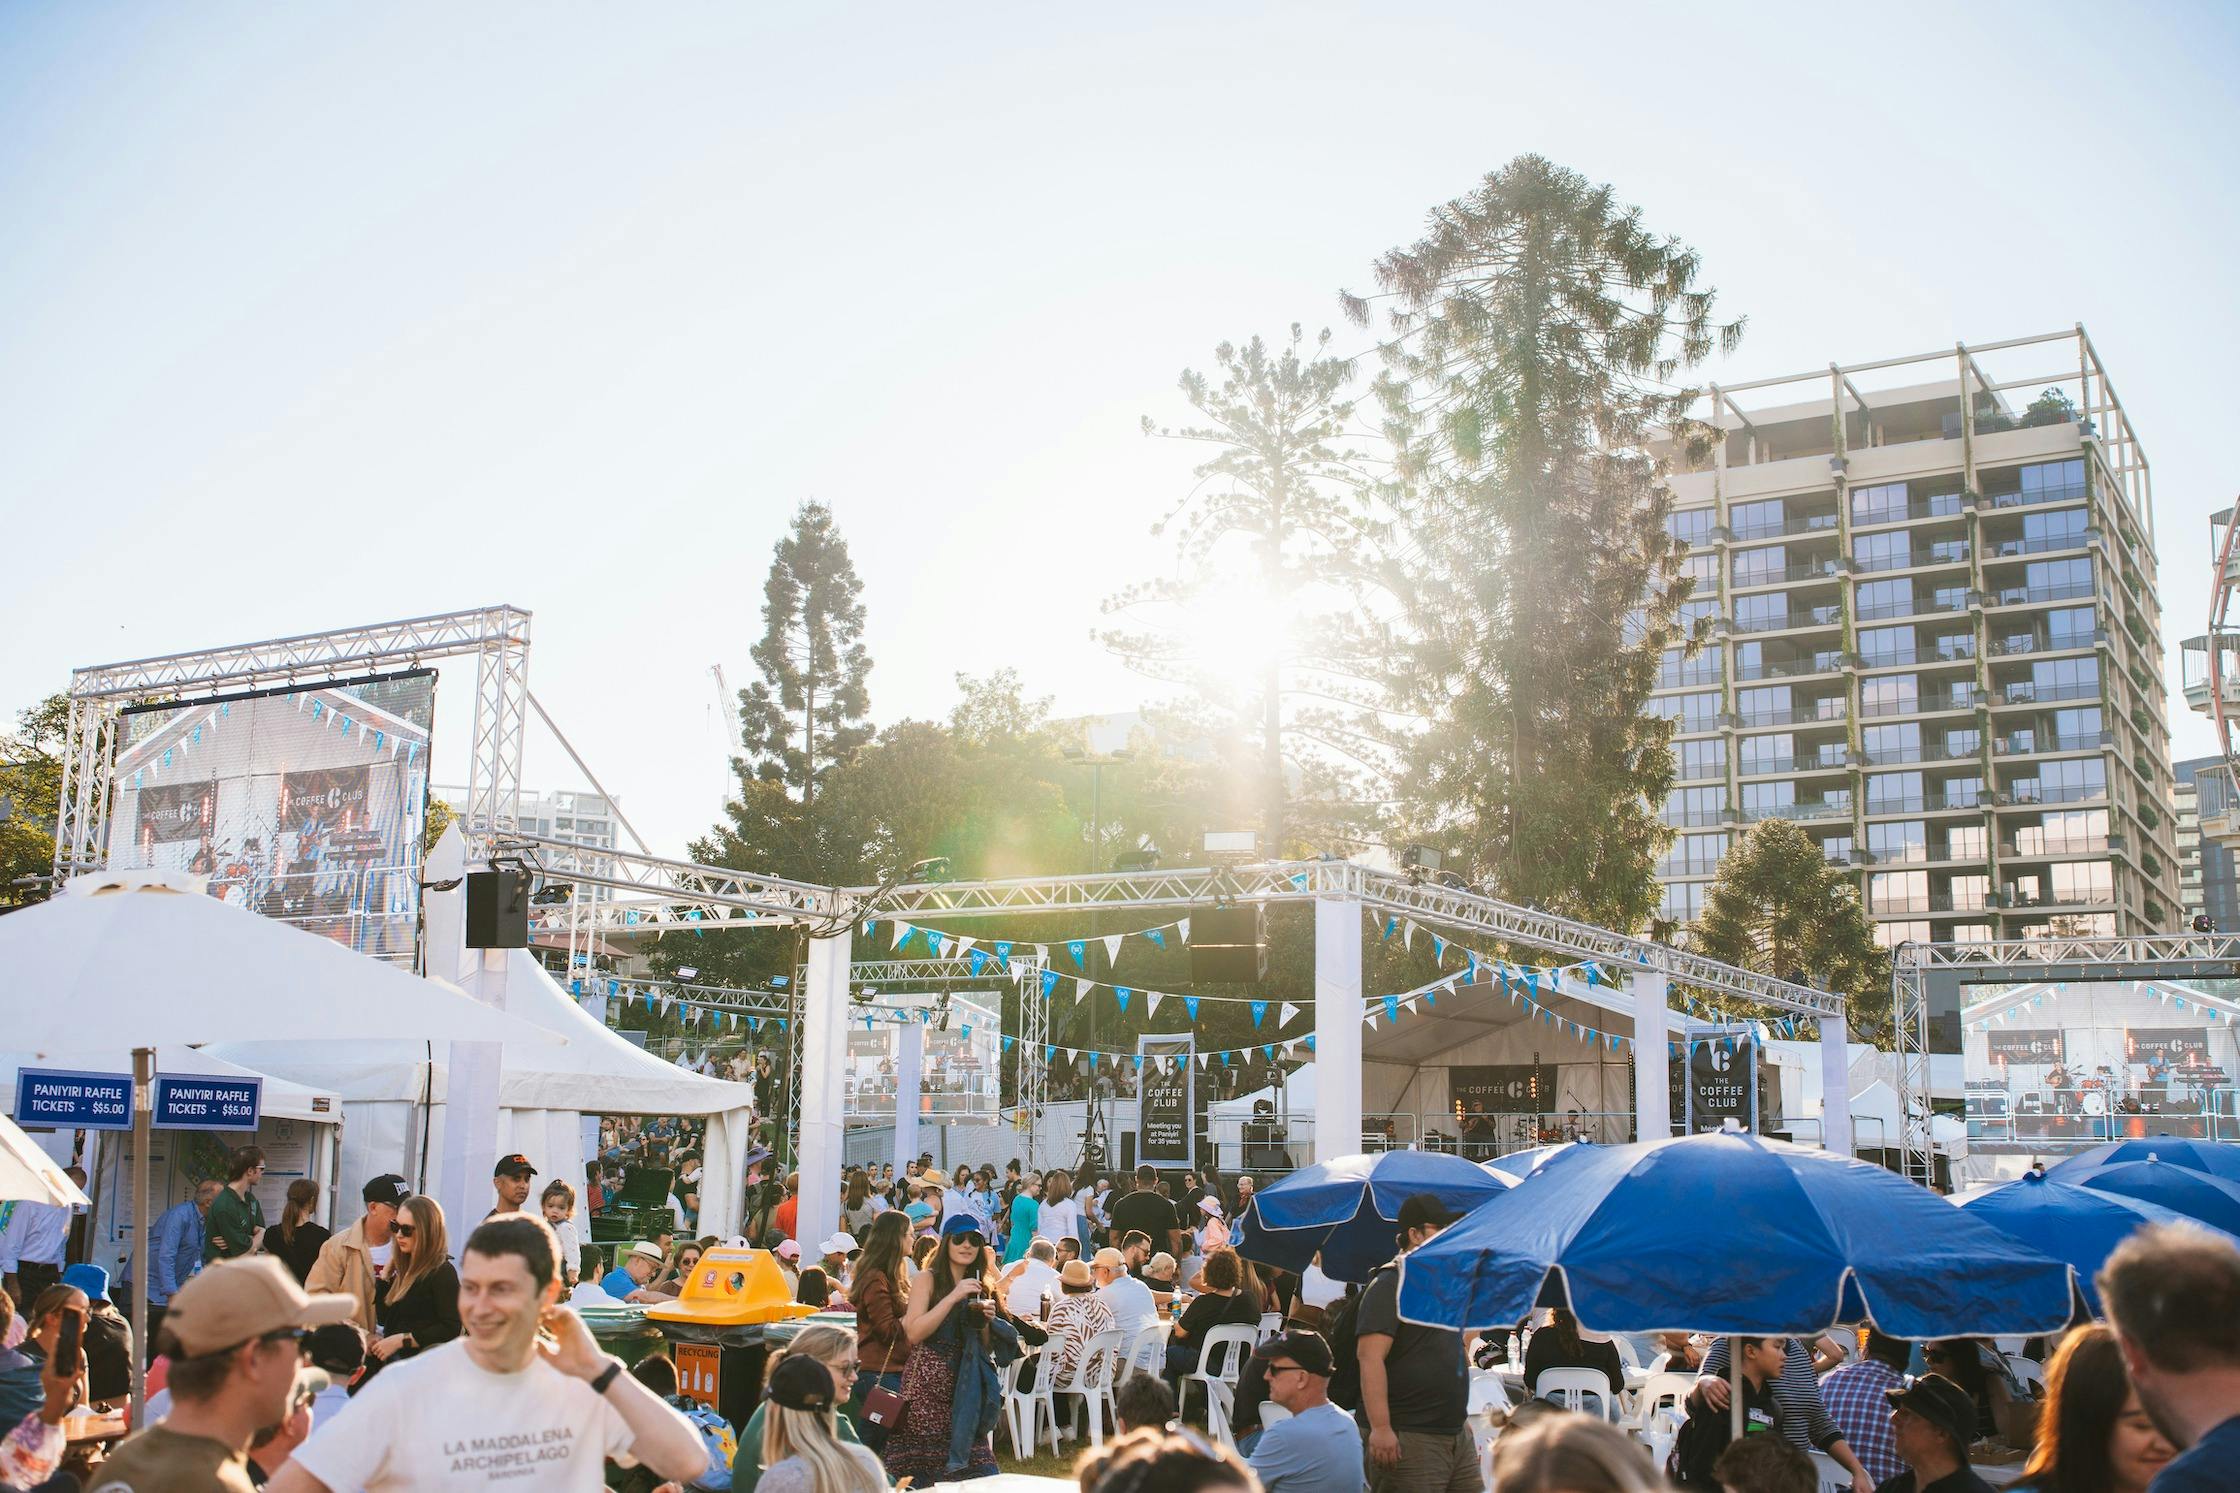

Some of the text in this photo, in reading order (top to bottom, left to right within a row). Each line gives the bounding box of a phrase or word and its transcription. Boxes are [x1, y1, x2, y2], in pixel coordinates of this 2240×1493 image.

[296, 795, 325, 806] COFFEE
[342, 790, 363, 802] CLUB
[2141, 1042, 2168, 1050] COFFEE
[34, 1084, 122, 1100] PANIYIRI RAFFLE
[169, 1088, 250, 1102] PANIYIRI RAFFLE
[1148, 1089, 1183, 1097] COFFEE
[1468, 1086, 1505, 1094] COFFEE
[1699, 1086, 1743, 1096] COFFEE
[32, 1100, 75, 1113] TICKETS
[92, 1101, 125, 1115] $$5.00
[1154, 1099, 1177, 1107] CLUB
[1707, 1097, 1738, 1108] CLUB
[168, 1103, 207, 1115] TICKETS
[222, 1104, 252, 1116] $$5.00
[1147, 1122, 1171, 1130] Meeting
[1147, 1137, 1157, 1145] for
[1165, 1138, 1181, 1146] years
[678, 1347, 719, 1359] RECYCLING
[442, 1427, 573, 1456] LA MADDALENA
[450, 1445, 570, 1473] ARCHIPELAGO
